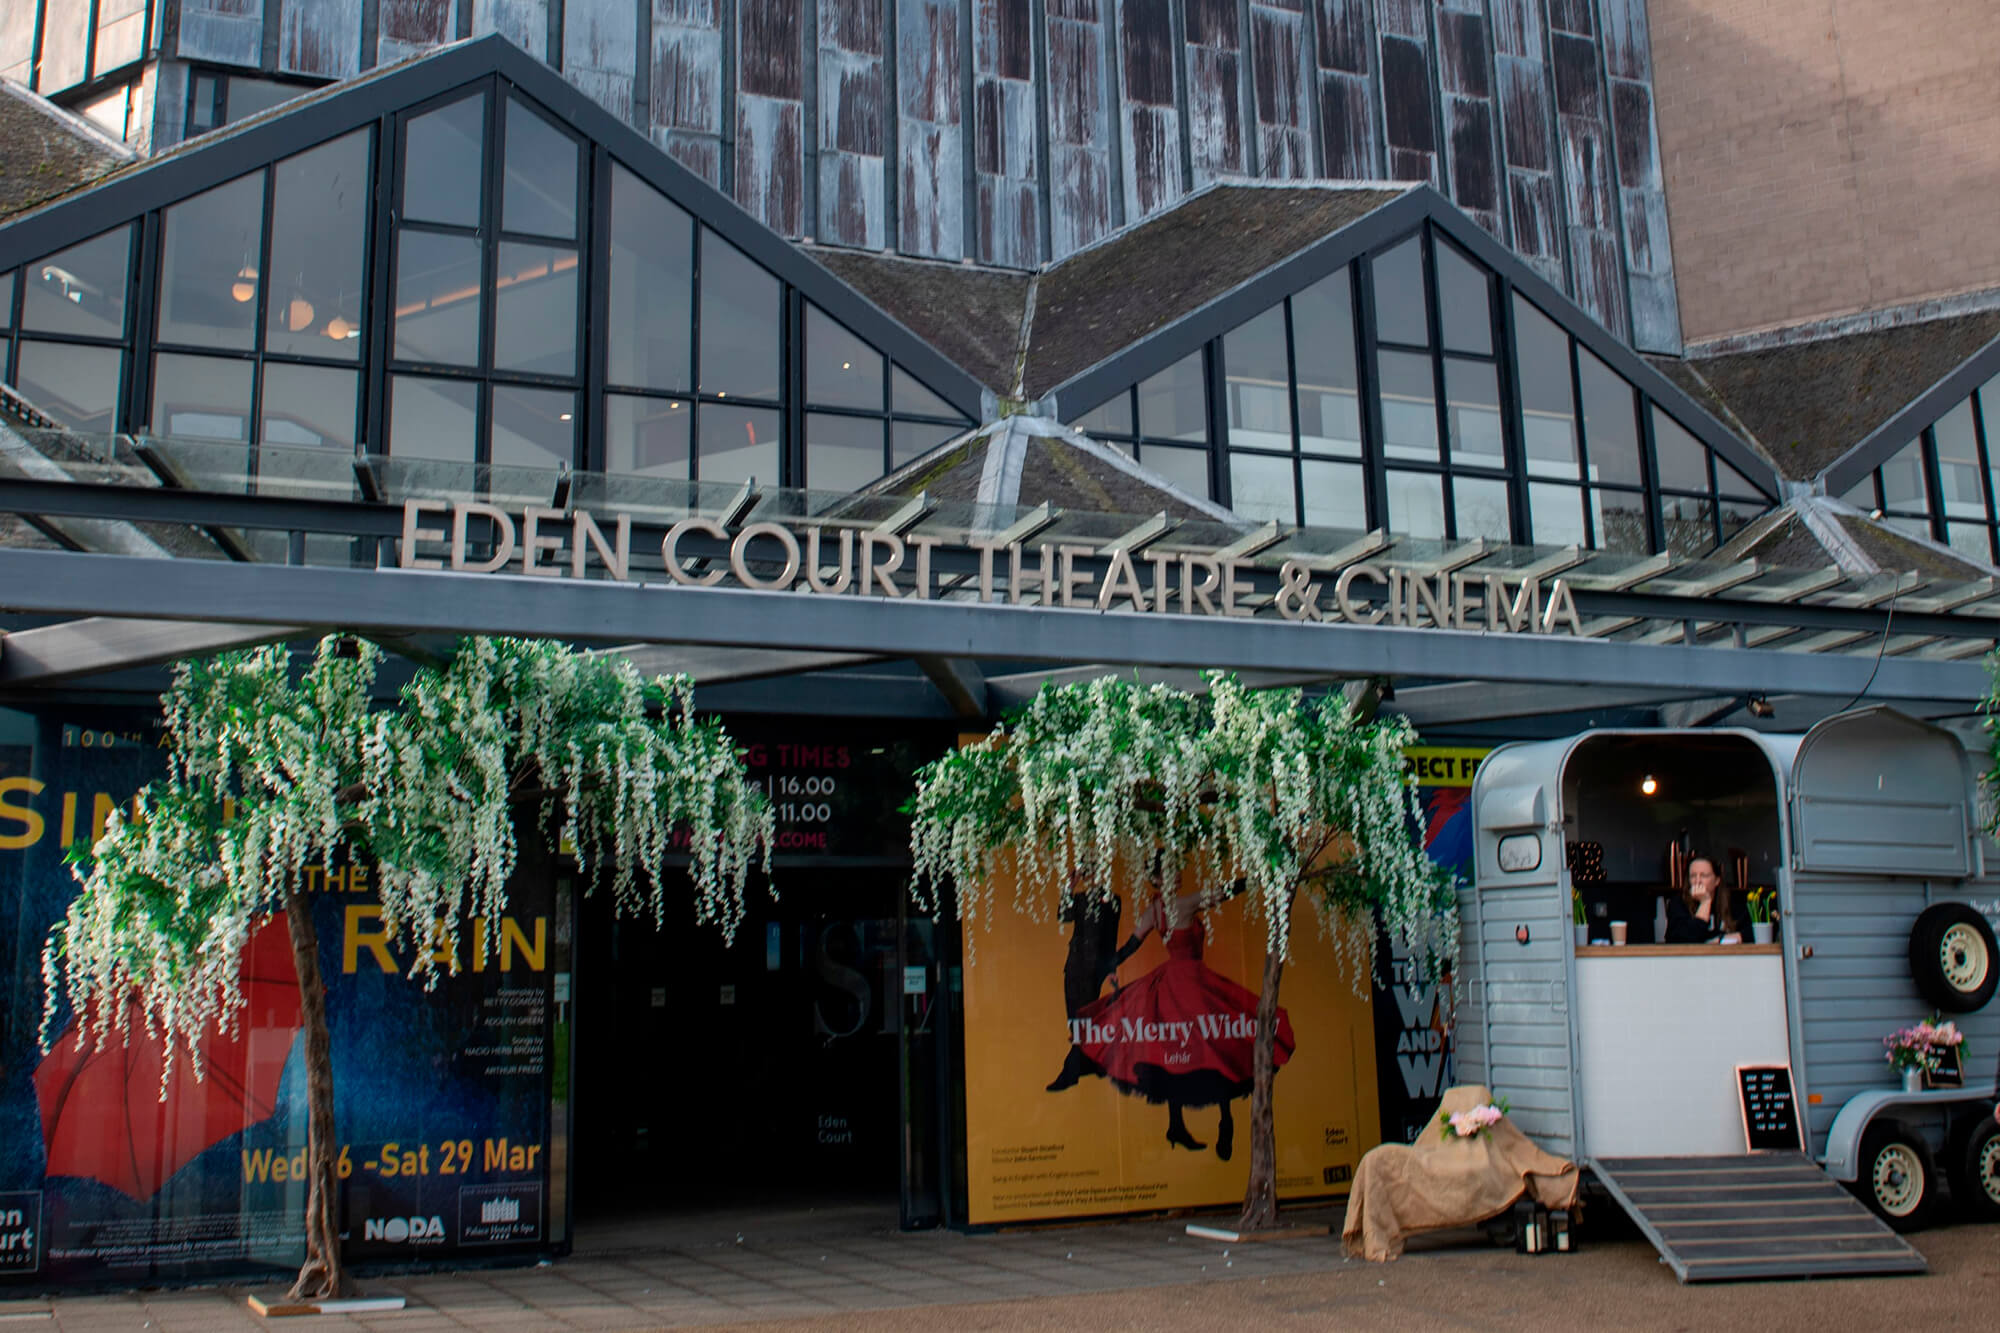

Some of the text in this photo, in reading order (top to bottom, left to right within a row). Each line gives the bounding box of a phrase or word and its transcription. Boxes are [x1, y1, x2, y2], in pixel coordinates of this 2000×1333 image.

[402, 499, 1582, 636] EDEN COURT THEATRE & CINEMA
[776, 745, 850, 769] TIMES
[779, 776, 835, 796] 16.00
[779, 803, 831, 823] 11.00
[303, 866, 369, 892] THE
[1067, 1012, 1281, 1048] The Merry Wido
[818, 1113, 848, 1129] Eden
[818, 1129, 853, 1145] Court
[242, 1149, 308, 1183] Wed
[440, 1139, 473, 1174] 29
[484, 1138, 541, 1171] Mar
[363, 1214, 447, 1244] NODA
